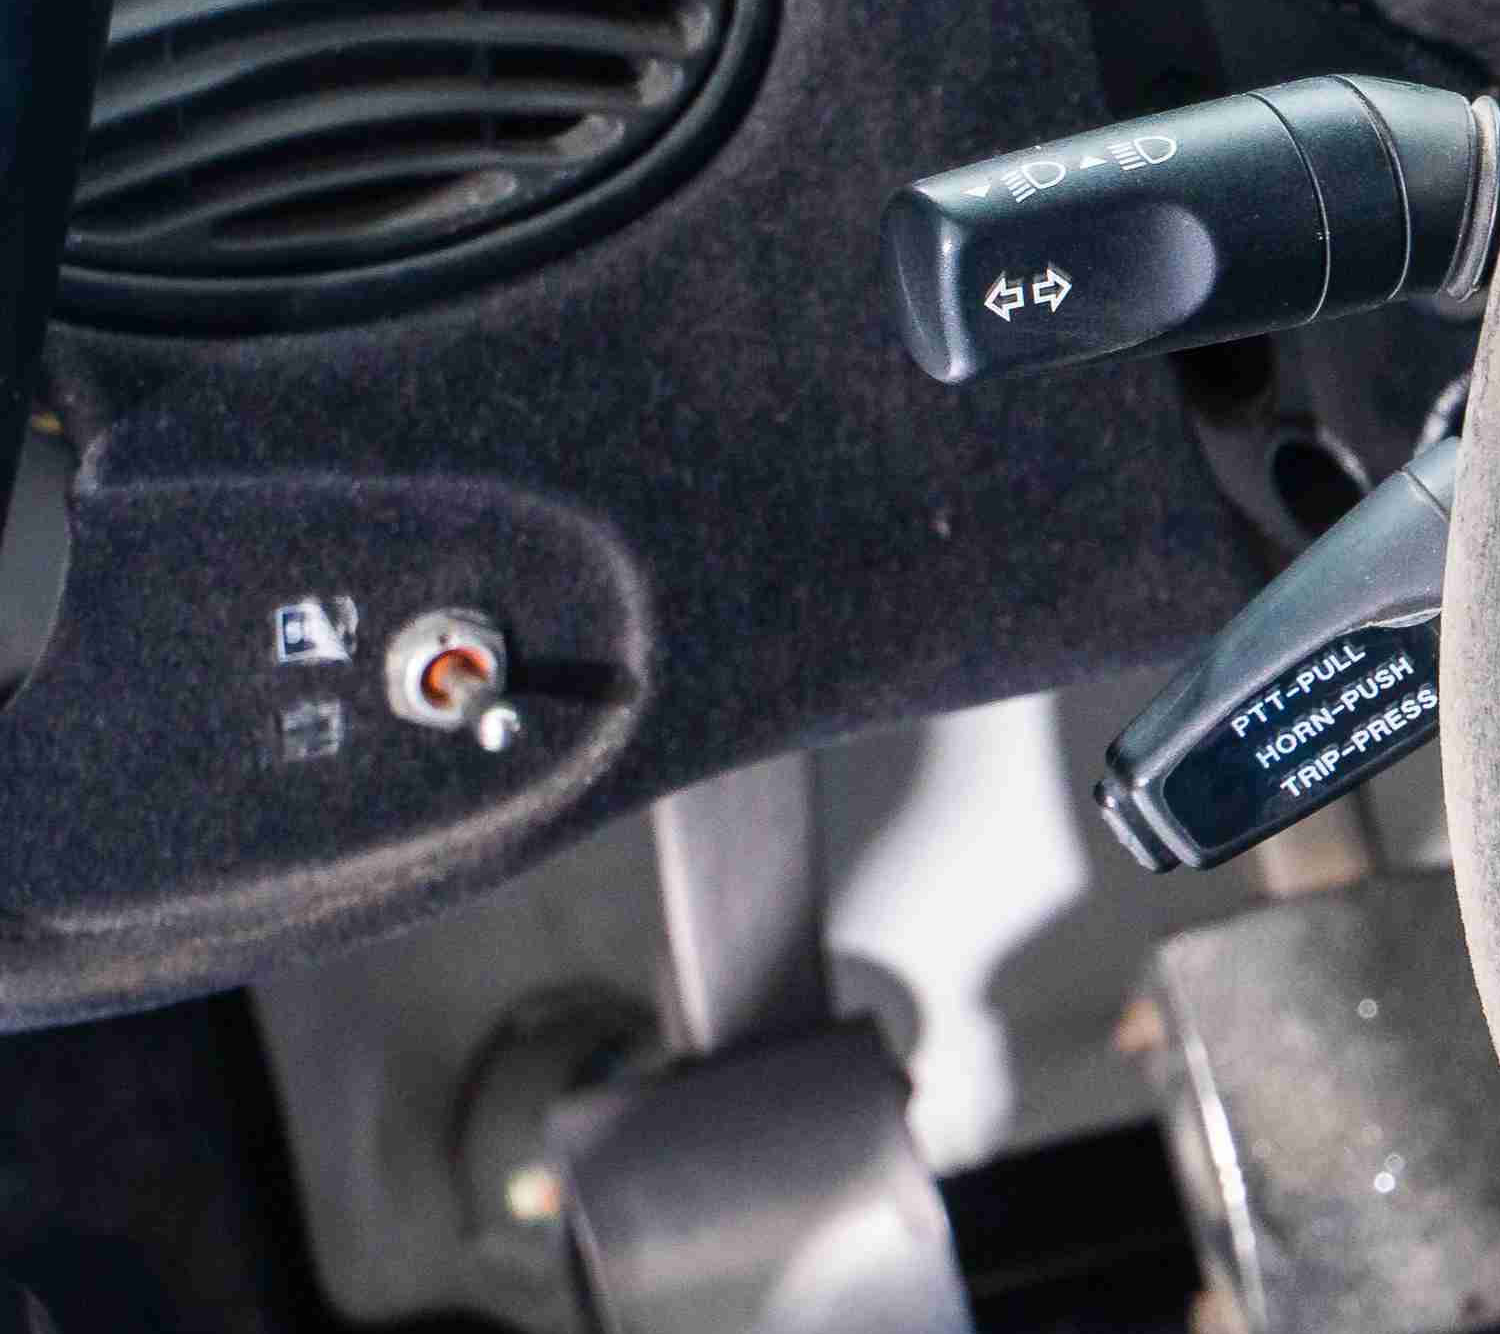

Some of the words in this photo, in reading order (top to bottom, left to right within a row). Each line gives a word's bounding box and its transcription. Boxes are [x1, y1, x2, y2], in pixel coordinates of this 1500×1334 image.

[1230, 644, 1367, 739] PTT-PULL
[1254, 656, 1415, 770] HORN-PUSH
[1279, 688, 1439, 798] TRIP-PRESS
